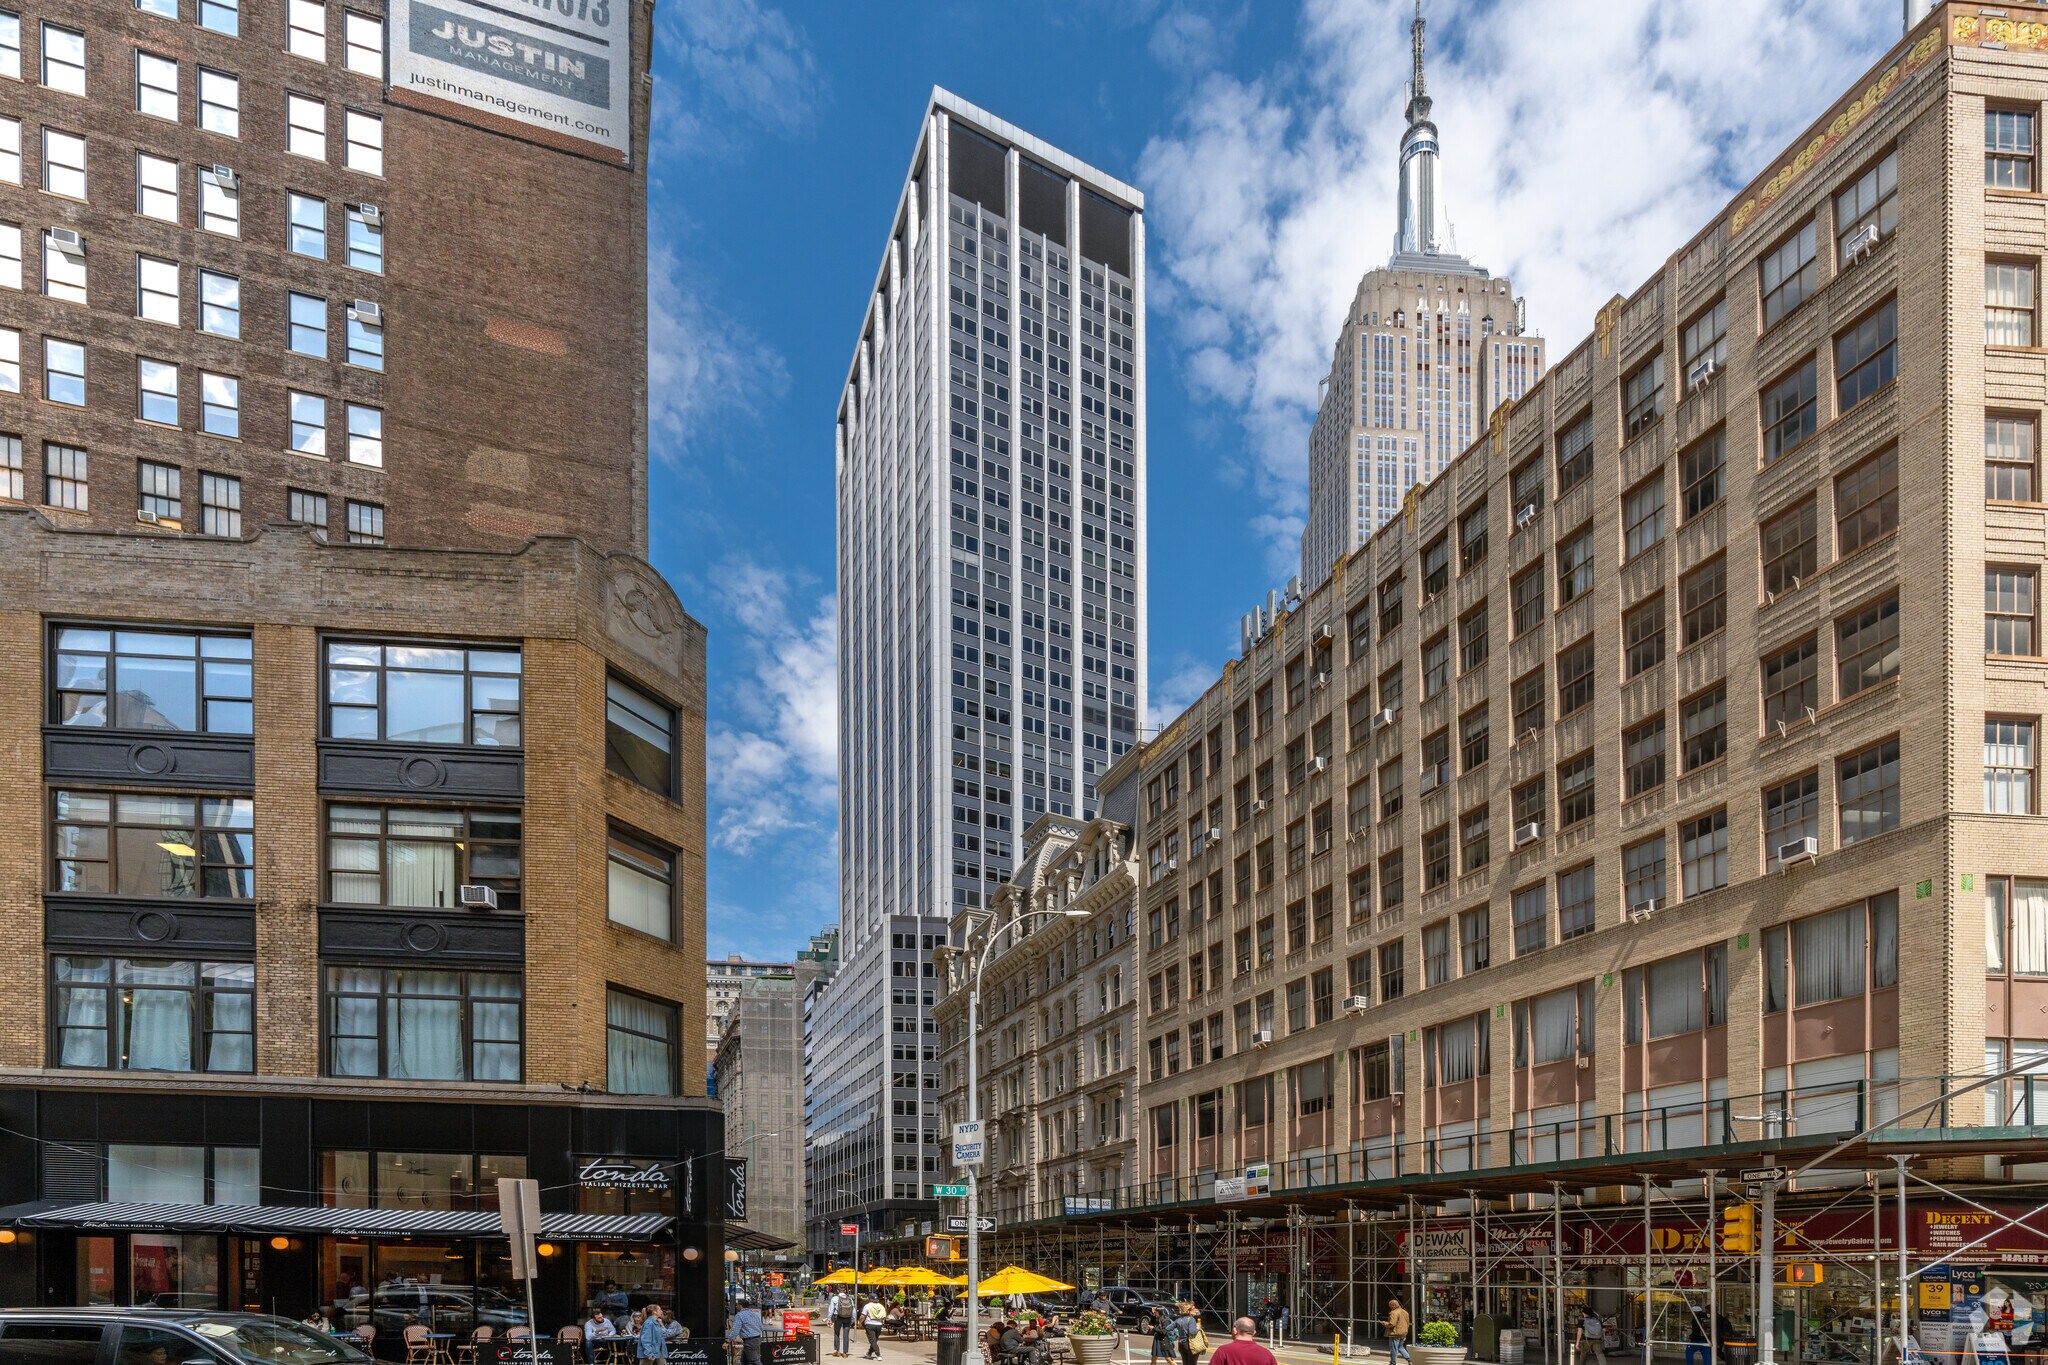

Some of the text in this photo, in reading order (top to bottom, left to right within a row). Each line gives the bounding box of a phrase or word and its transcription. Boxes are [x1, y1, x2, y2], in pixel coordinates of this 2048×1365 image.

[431, 20, 585, 80] JUSTIN
[450, 46, 574, 90] MANAGEMENT
[409, 72, 610, 137] justinmanagement.com
[959, 1123, 979, 1134] NYPD
[579, 1157, 670, 1182] tonda
[726, 1162, 746, 1218] tonda
[936, 1186, 943, 1195] W
[946, 1186, 957, 1195] 30
[1926, 1211, 1993, 1225] DECENT
[1414, 1232, 1464, 1247] DEWAN
[1650, 1227, 1805, 1249] DECT
[1808, 1237, 1892, 1245] www.JewelryGalore.om
[2001, 1253, 2039, 1263] HAIR
[1951, 1269, 1976, 1280] Lyca
[513, 1347, 553, 1359] tonda
[668, 1348, 708, 1359] tonda
[782, 1344, 806, 1356] tonda
